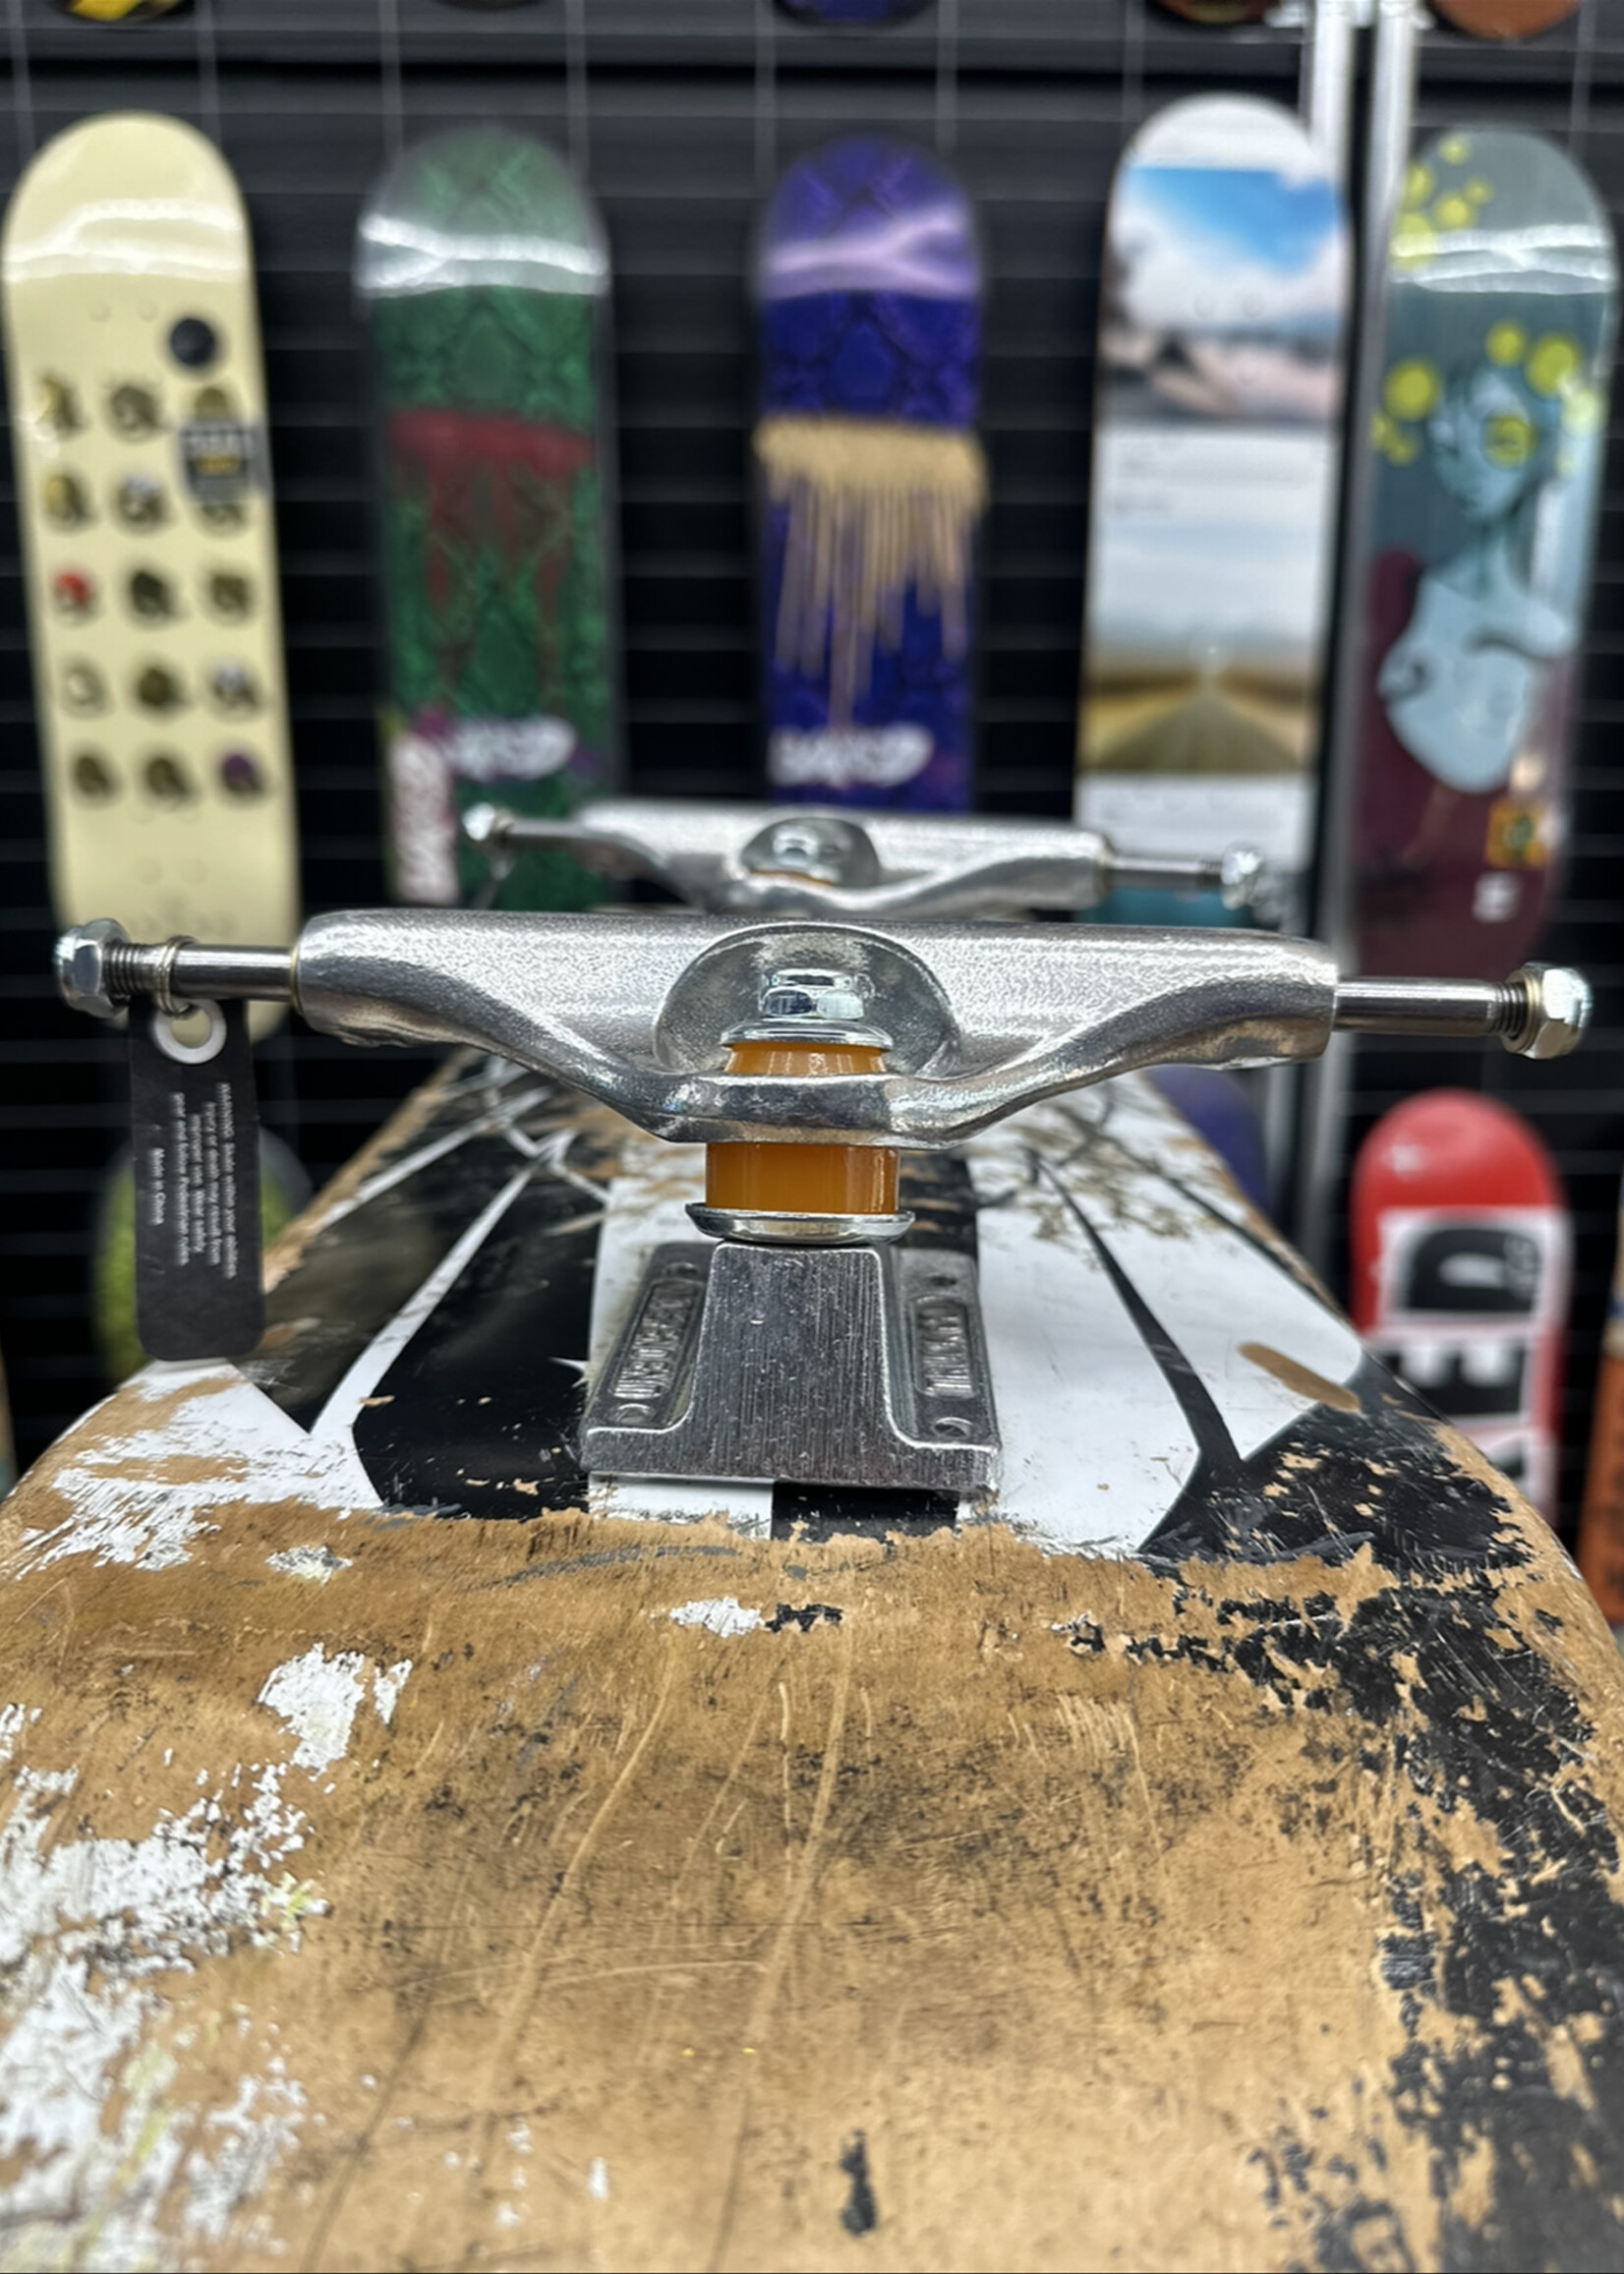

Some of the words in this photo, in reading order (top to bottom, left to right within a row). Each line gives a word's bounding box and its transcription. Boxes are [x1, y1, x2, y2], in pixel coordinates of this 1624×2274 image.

[174, 1120, 187, 1141] and
[189, 1114, 203, 1163] improper
[150, 1147, 165, 1178] Made
[175, 1142, 189, 1175] follow
[205, 1148, 219, 1180] death
[206, 1181, 219, 1204] may
[222, 1175, 237, 1207] within
[150, 1192, 166, 1226] China
[207, 1205, 221, 1237] result
[223, 1208, 237, 1234] your
[192, 1219, 206, 1254] safety
[208, 1238, 222, 1265] from
